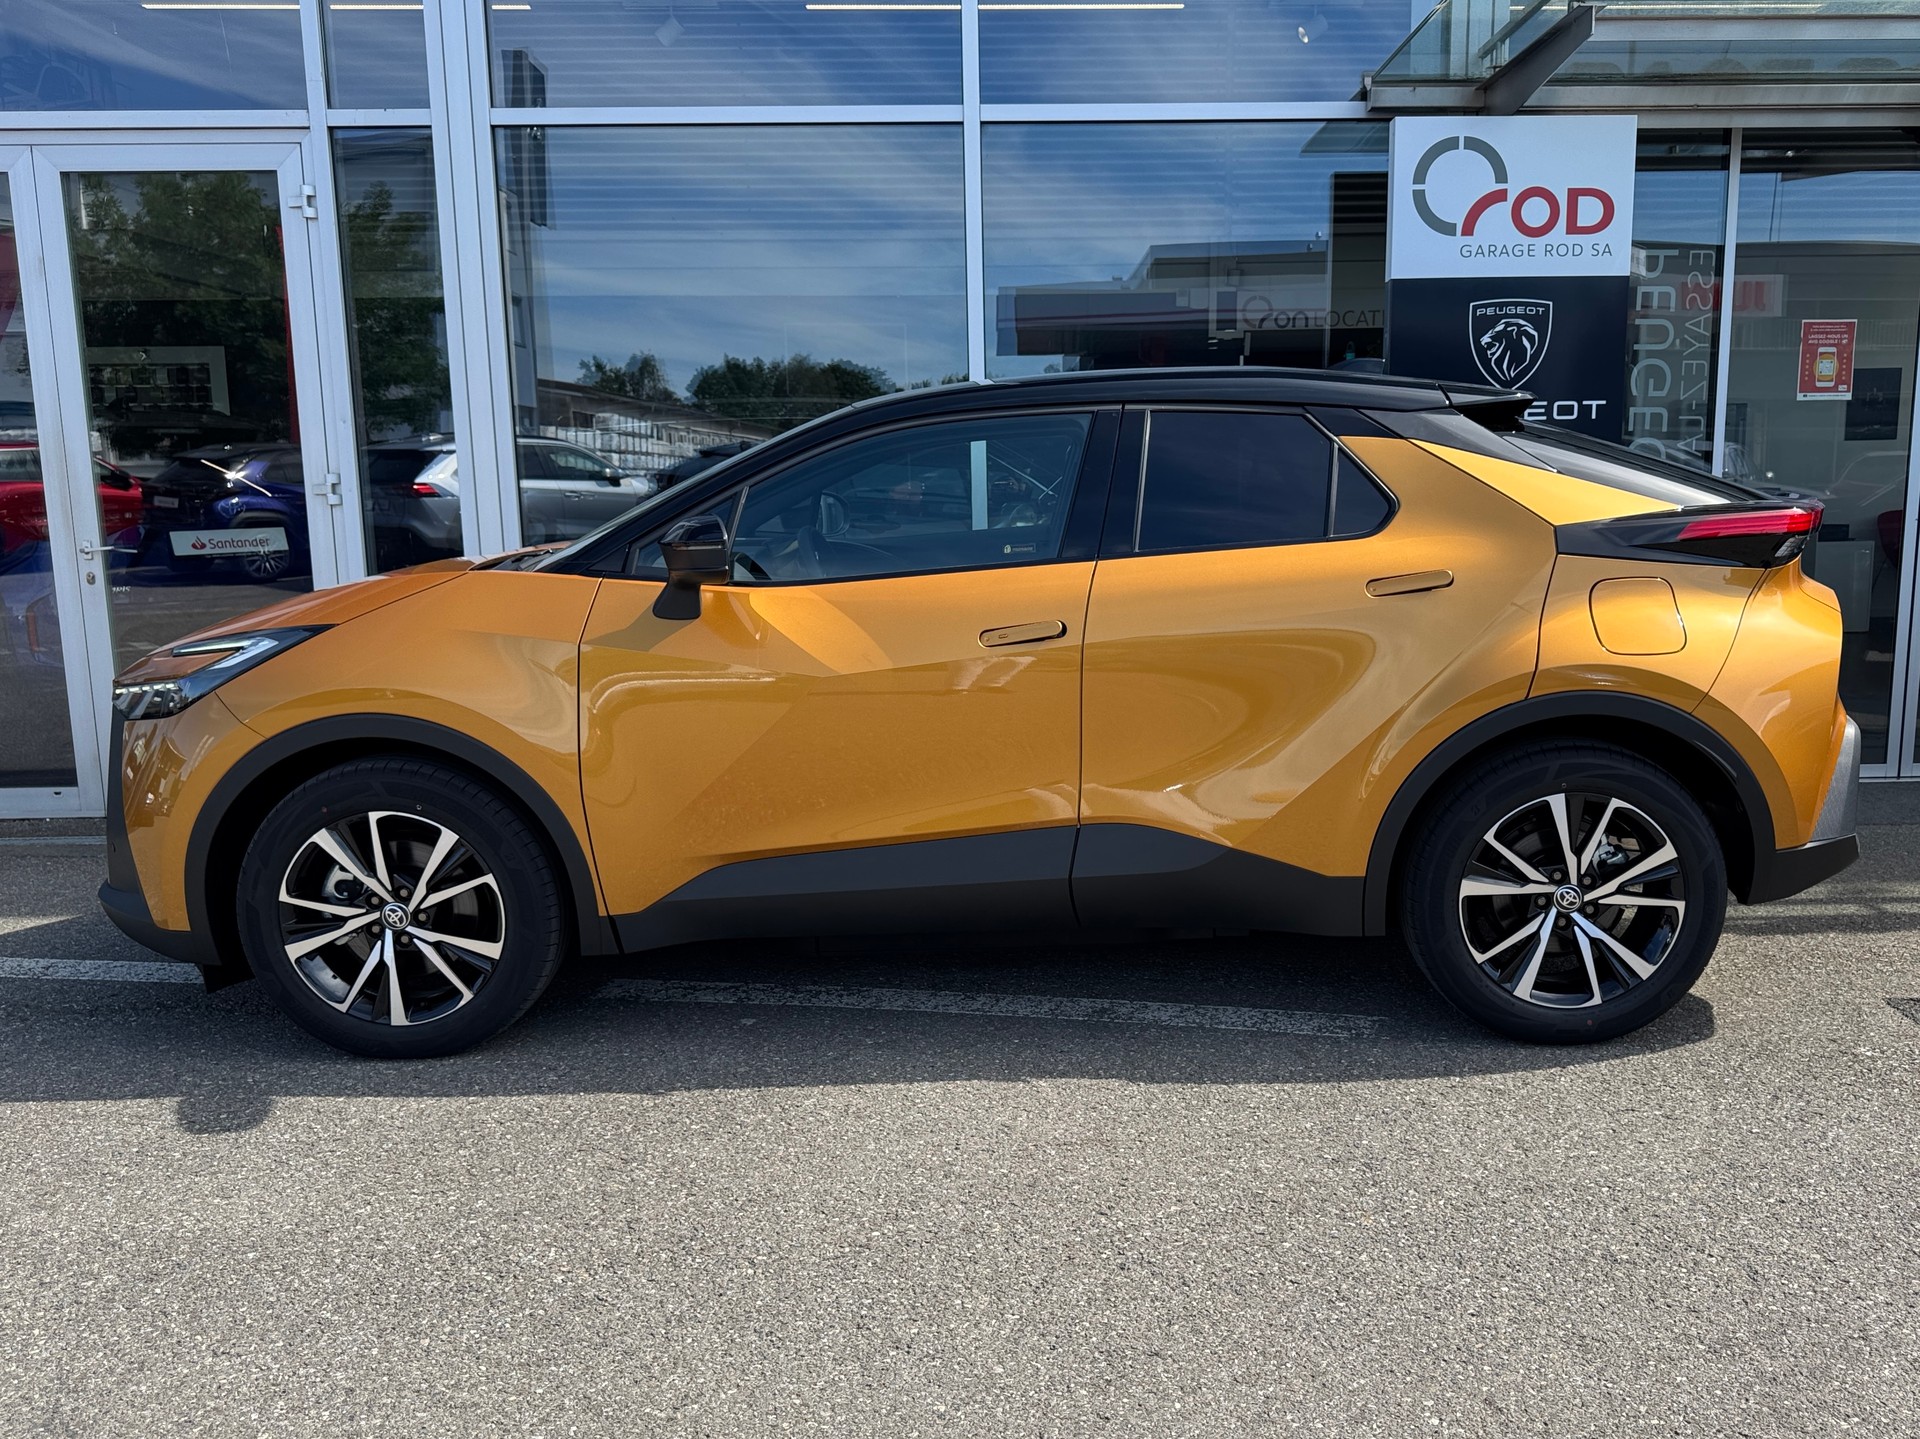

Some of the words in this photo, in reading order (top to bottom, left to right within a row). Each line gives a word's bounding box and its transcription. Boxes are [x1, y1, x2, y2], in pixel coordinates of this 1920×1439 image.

[1460, 243, 1536, 258] GARAGE
[1544, 243, 1583, 257] ROD
[1591, 242, 1613, 257] SA
[1476, 306, 1545, 316] PEUGEOT
[208, 537, 270, 550] Santander
